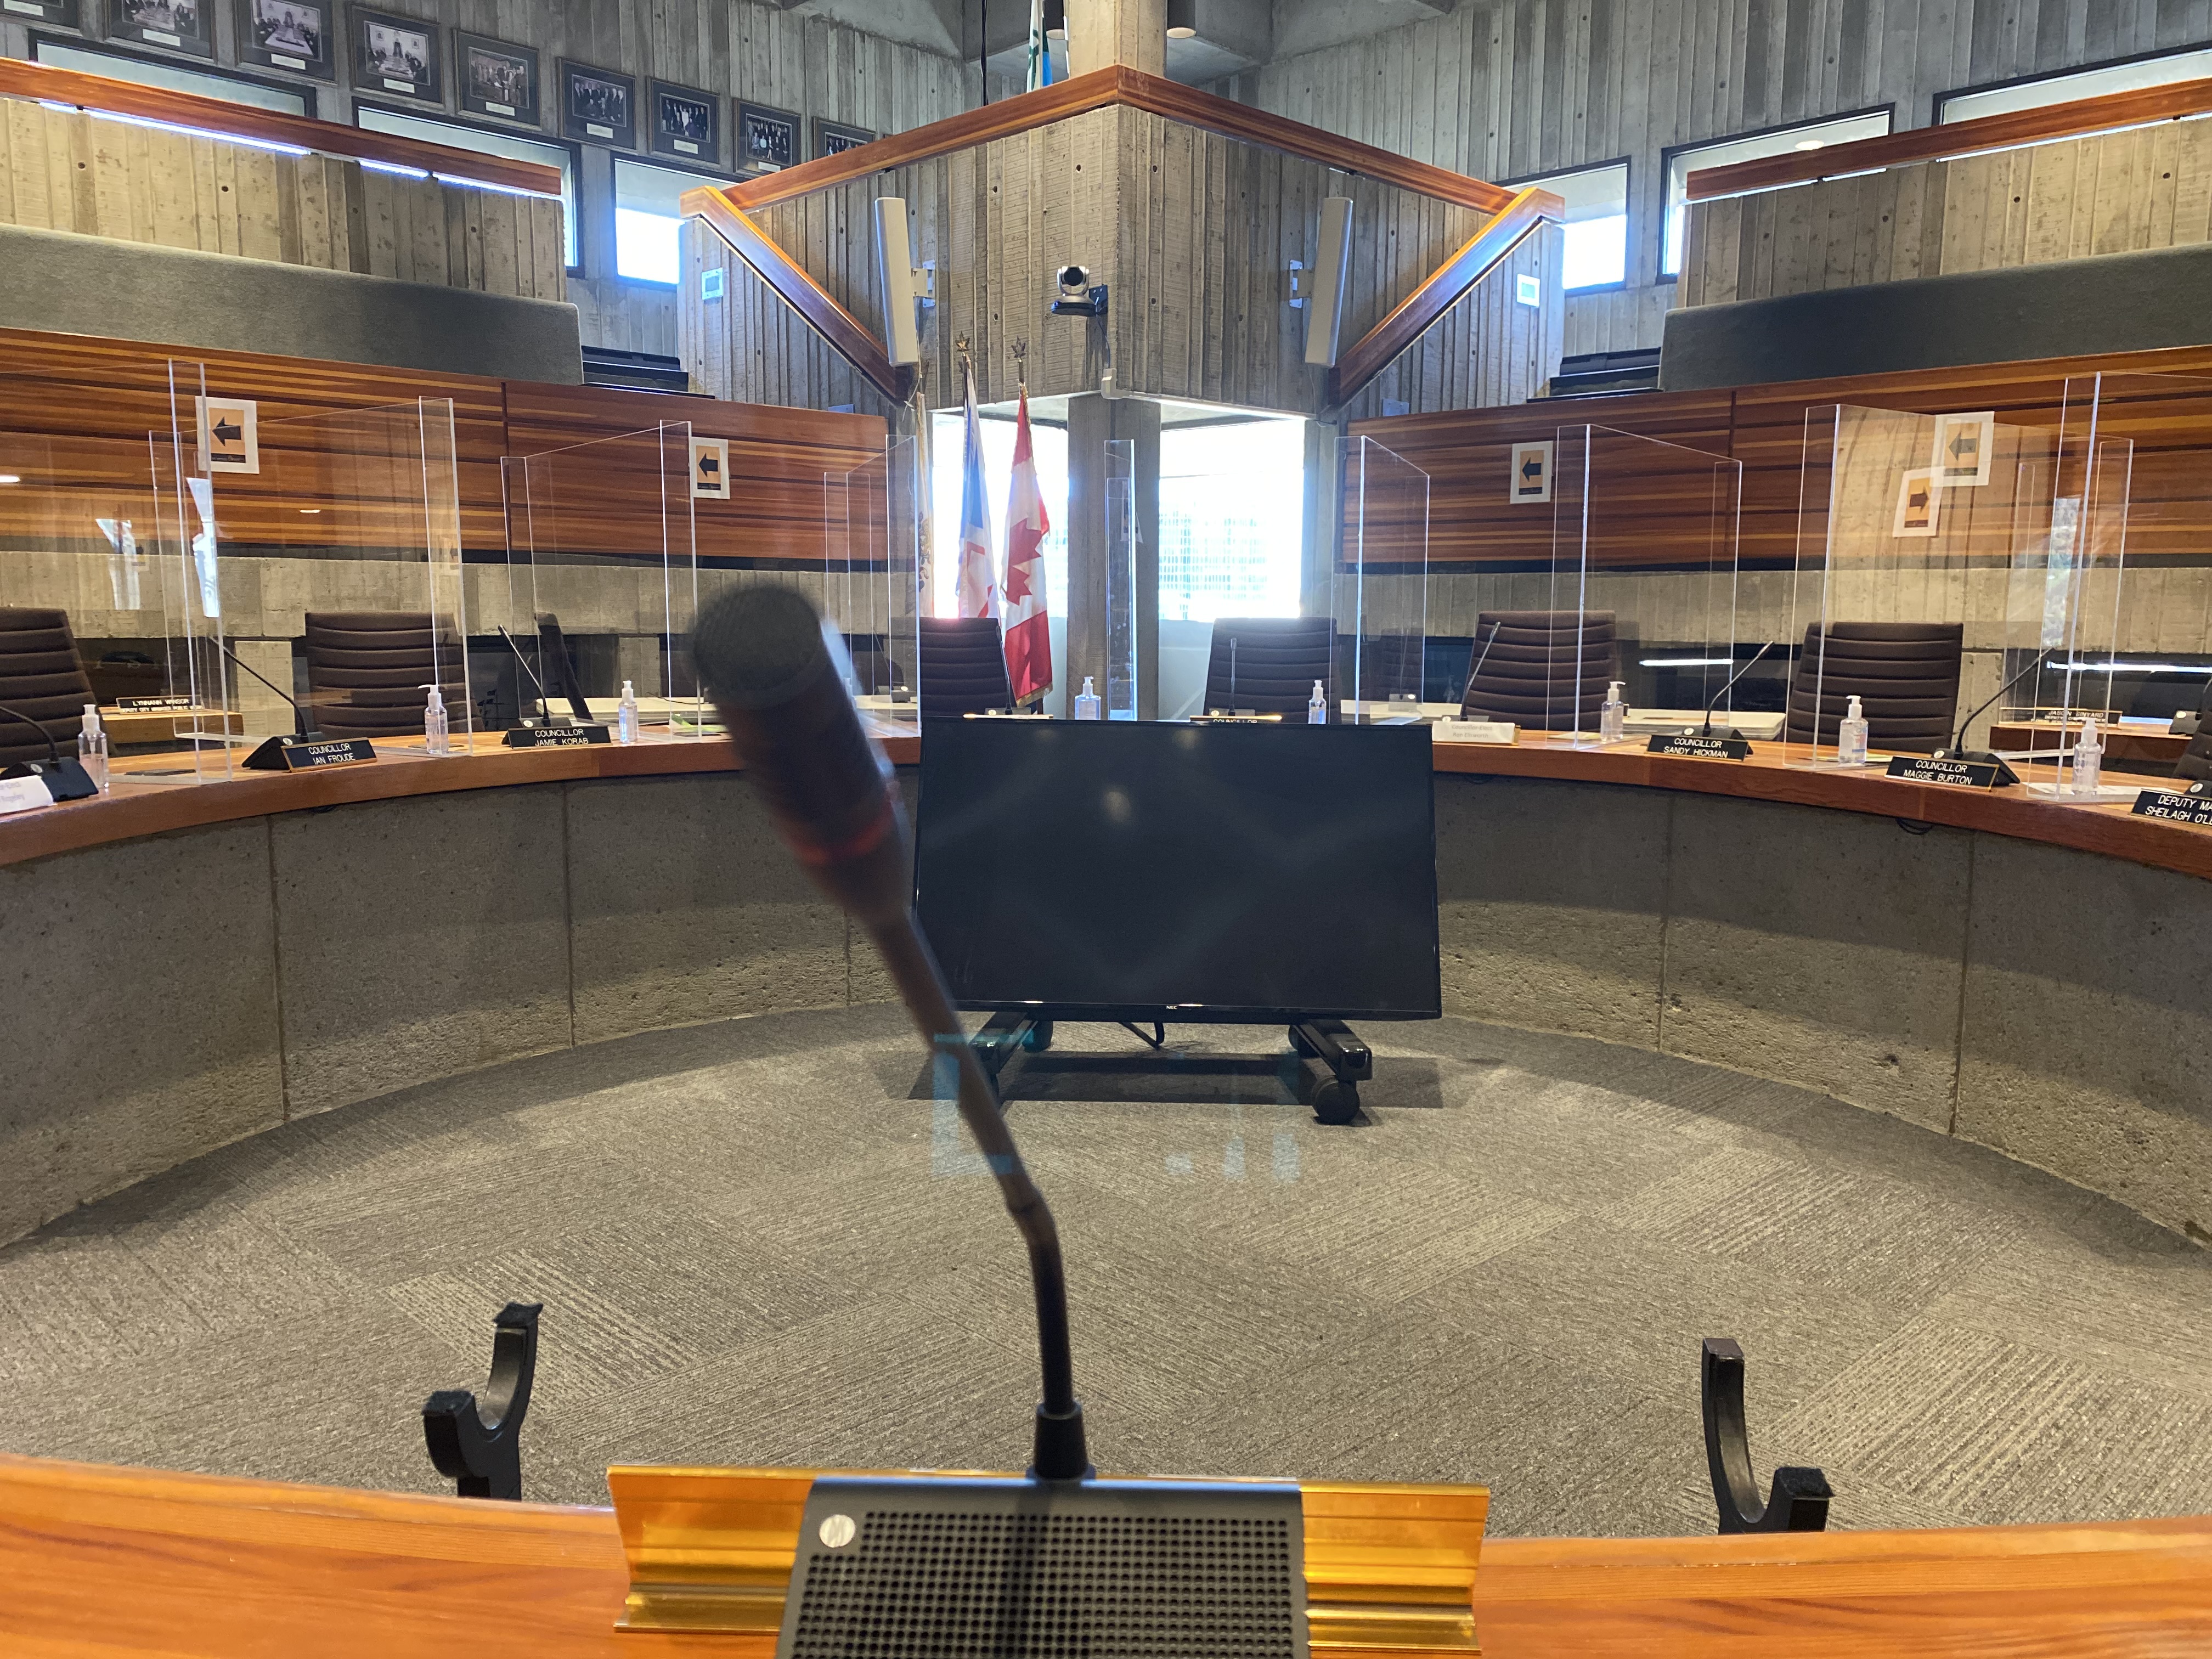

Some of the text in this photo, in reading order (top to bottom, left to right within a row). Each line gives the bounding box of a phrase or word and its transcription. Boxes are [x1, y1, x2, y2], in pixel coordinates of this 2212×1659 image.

[535, 729, 584, 737] COUNCILLOR
[1674, 737, 1723, 748] COUNCILLOR
[308, 743, 352, 755] COUNCILLOR
[1663, 746, 1729, 758] SANDY HICKMAN
[312, 753, 356, 765] IAN FROUDE
[1916, 760, 1968, 773] COUNCILLOR
[1903, 769, 1973, 785] MAGGIE BURTON
[2158, 795, 2197, 809] DEPUTY
[2145, 806, 2192, 821] SHEILAGH
